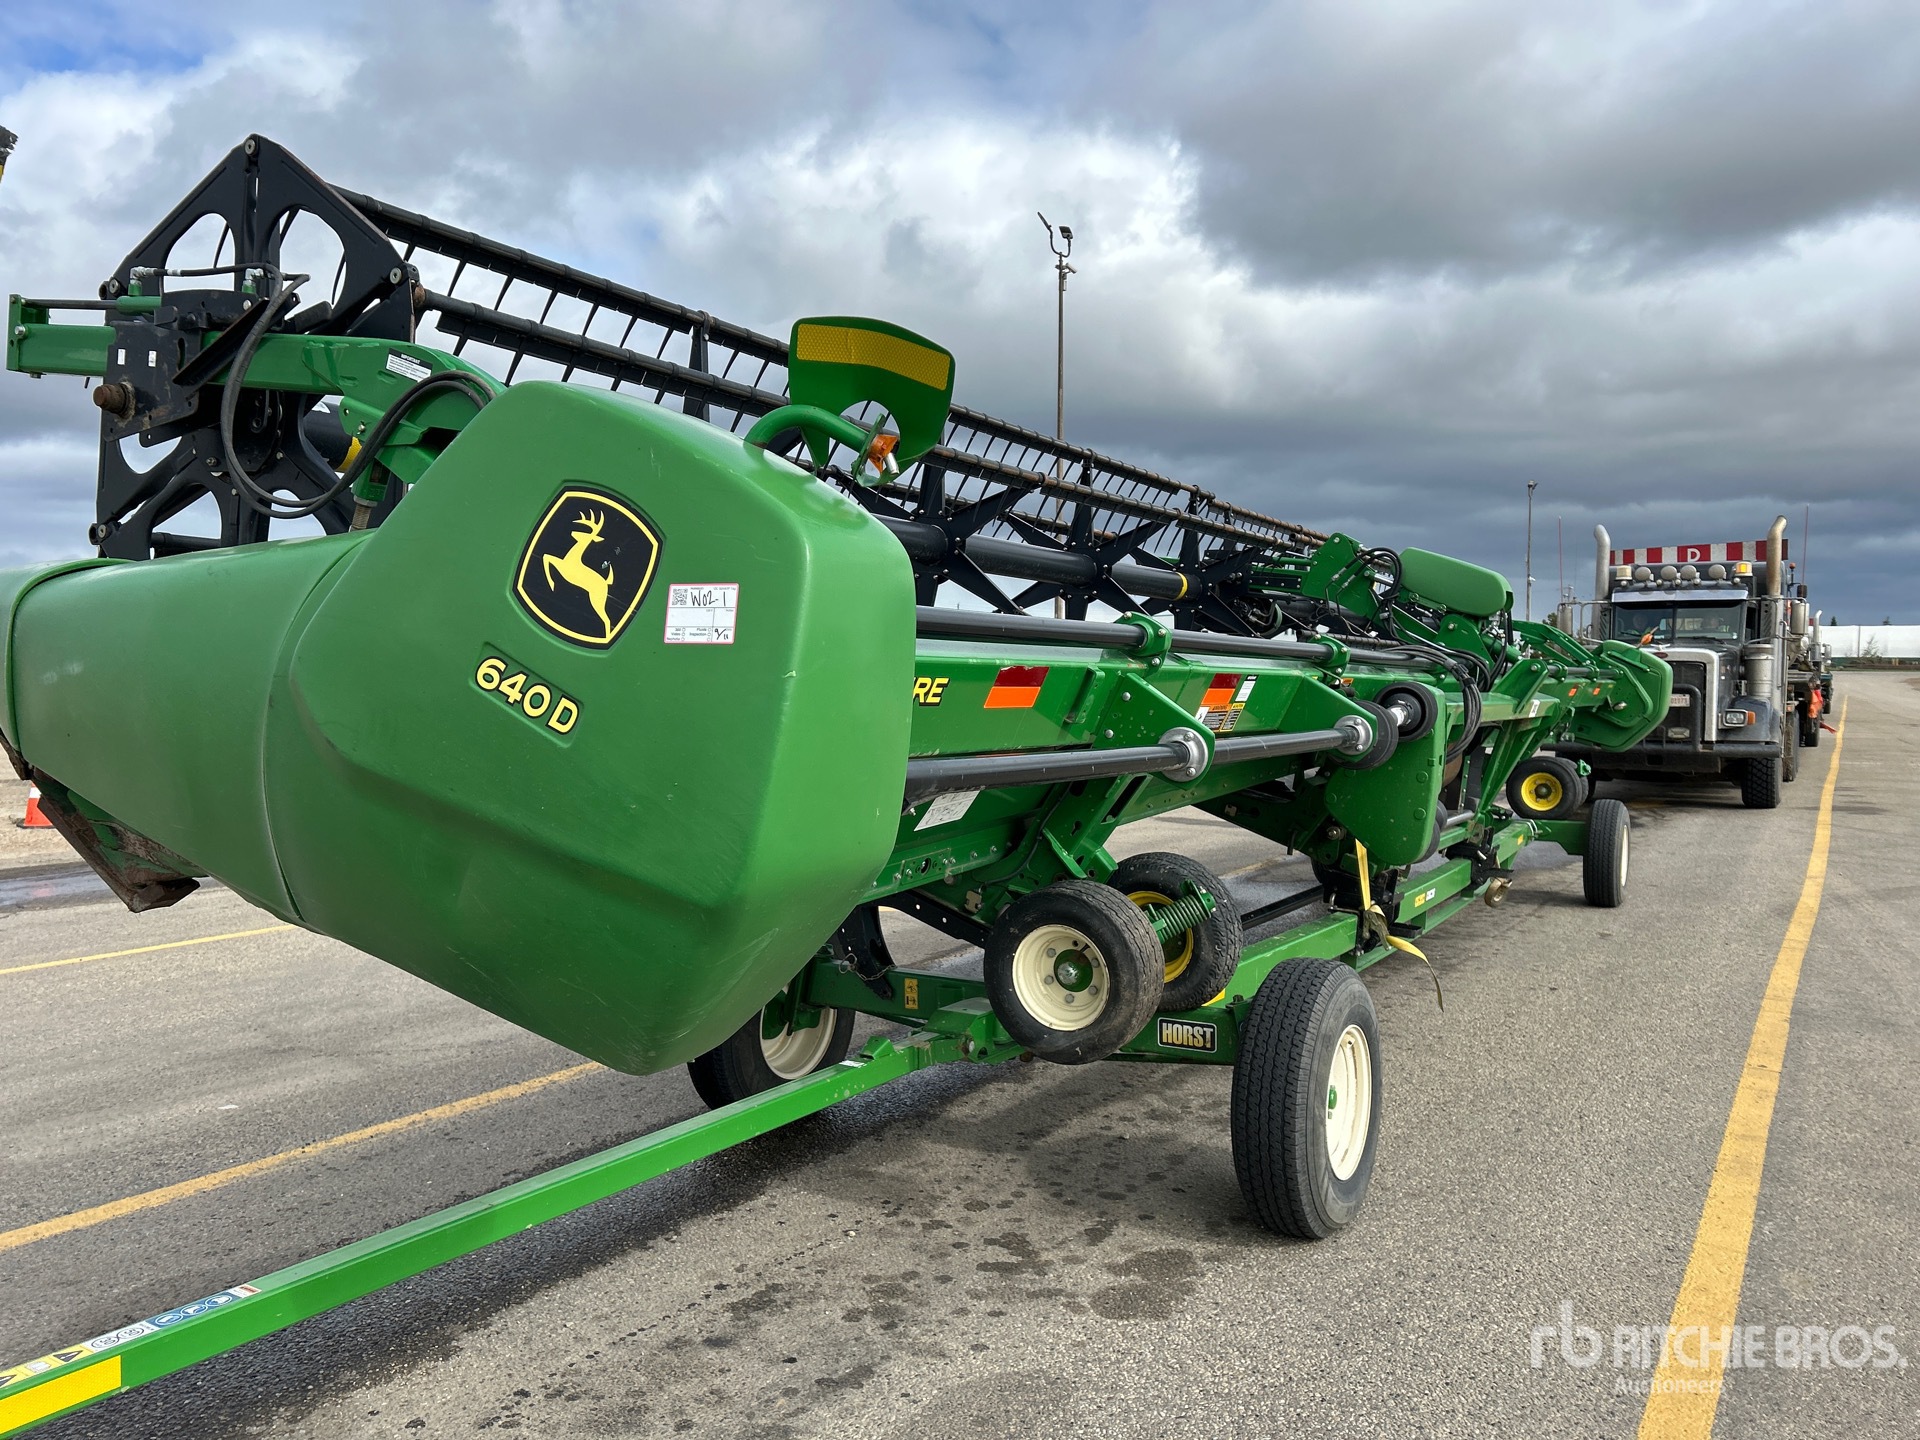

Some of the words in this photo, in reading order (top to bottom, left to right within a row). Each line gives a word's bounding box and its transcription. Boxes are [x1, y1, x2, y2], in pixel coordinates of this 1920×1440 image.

[1687, 548, 1701, 562] D
[912, 676, 950, 704] RE
[1161, 1021, 1214, 1049] HORST
